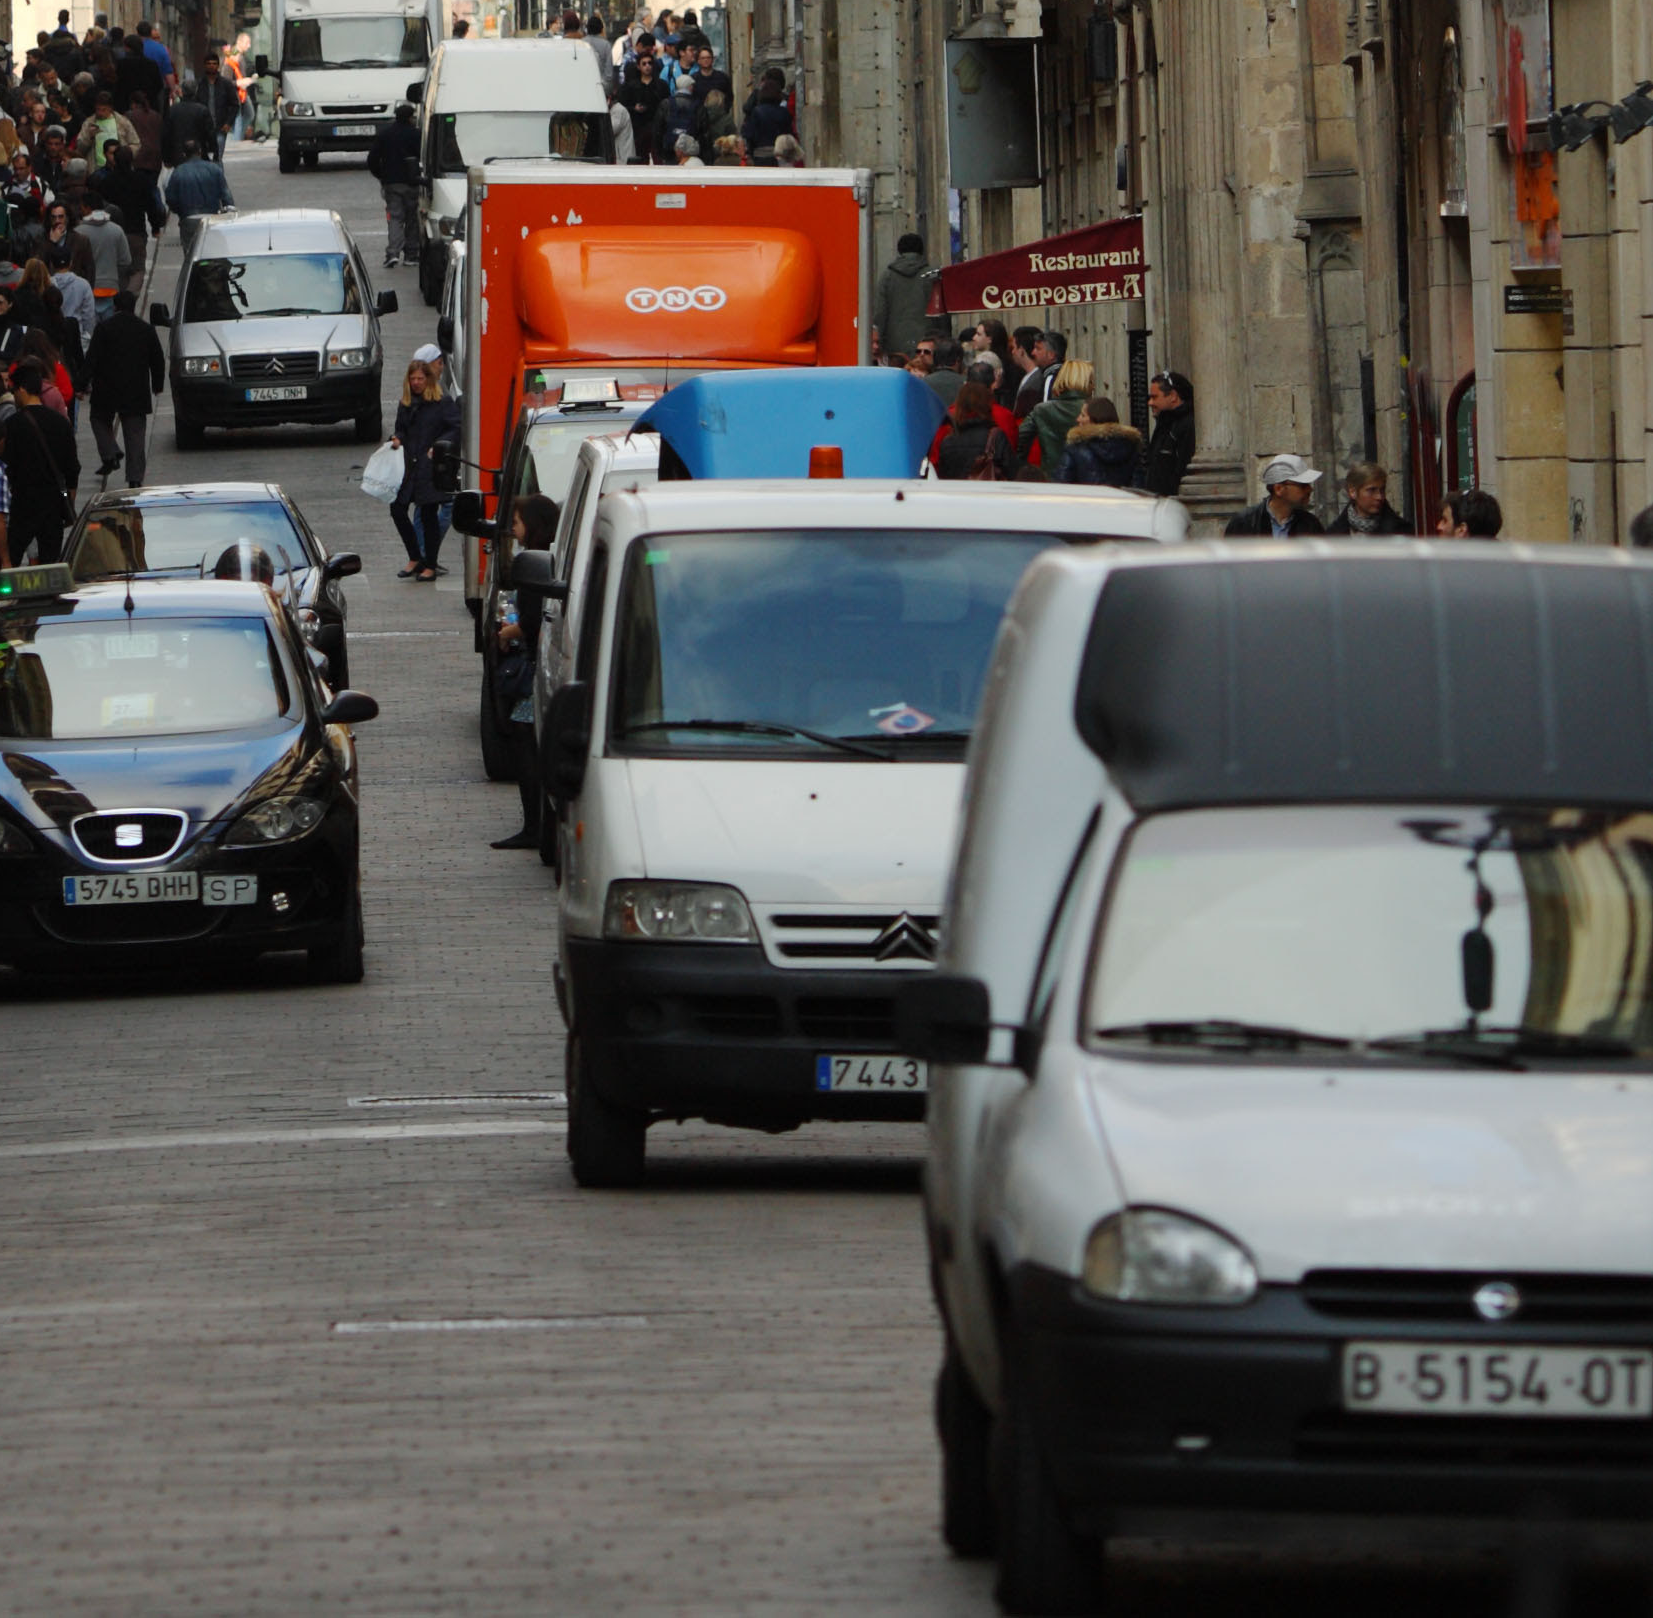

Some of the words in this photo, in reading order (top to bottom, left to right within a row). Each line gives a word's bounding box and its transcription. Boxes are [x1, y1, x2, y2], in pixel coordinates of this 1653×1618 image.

[1028, 246, 1140, 273] Restaurant
[981, 273, 1142, 309] COMPOSTELA
[253, 388, 279, 400] 7445
[15, 572, 47, 592] TAXI
[80, 878, 140, 901] 5745
[834, 1059, 919, 1088] 7443
